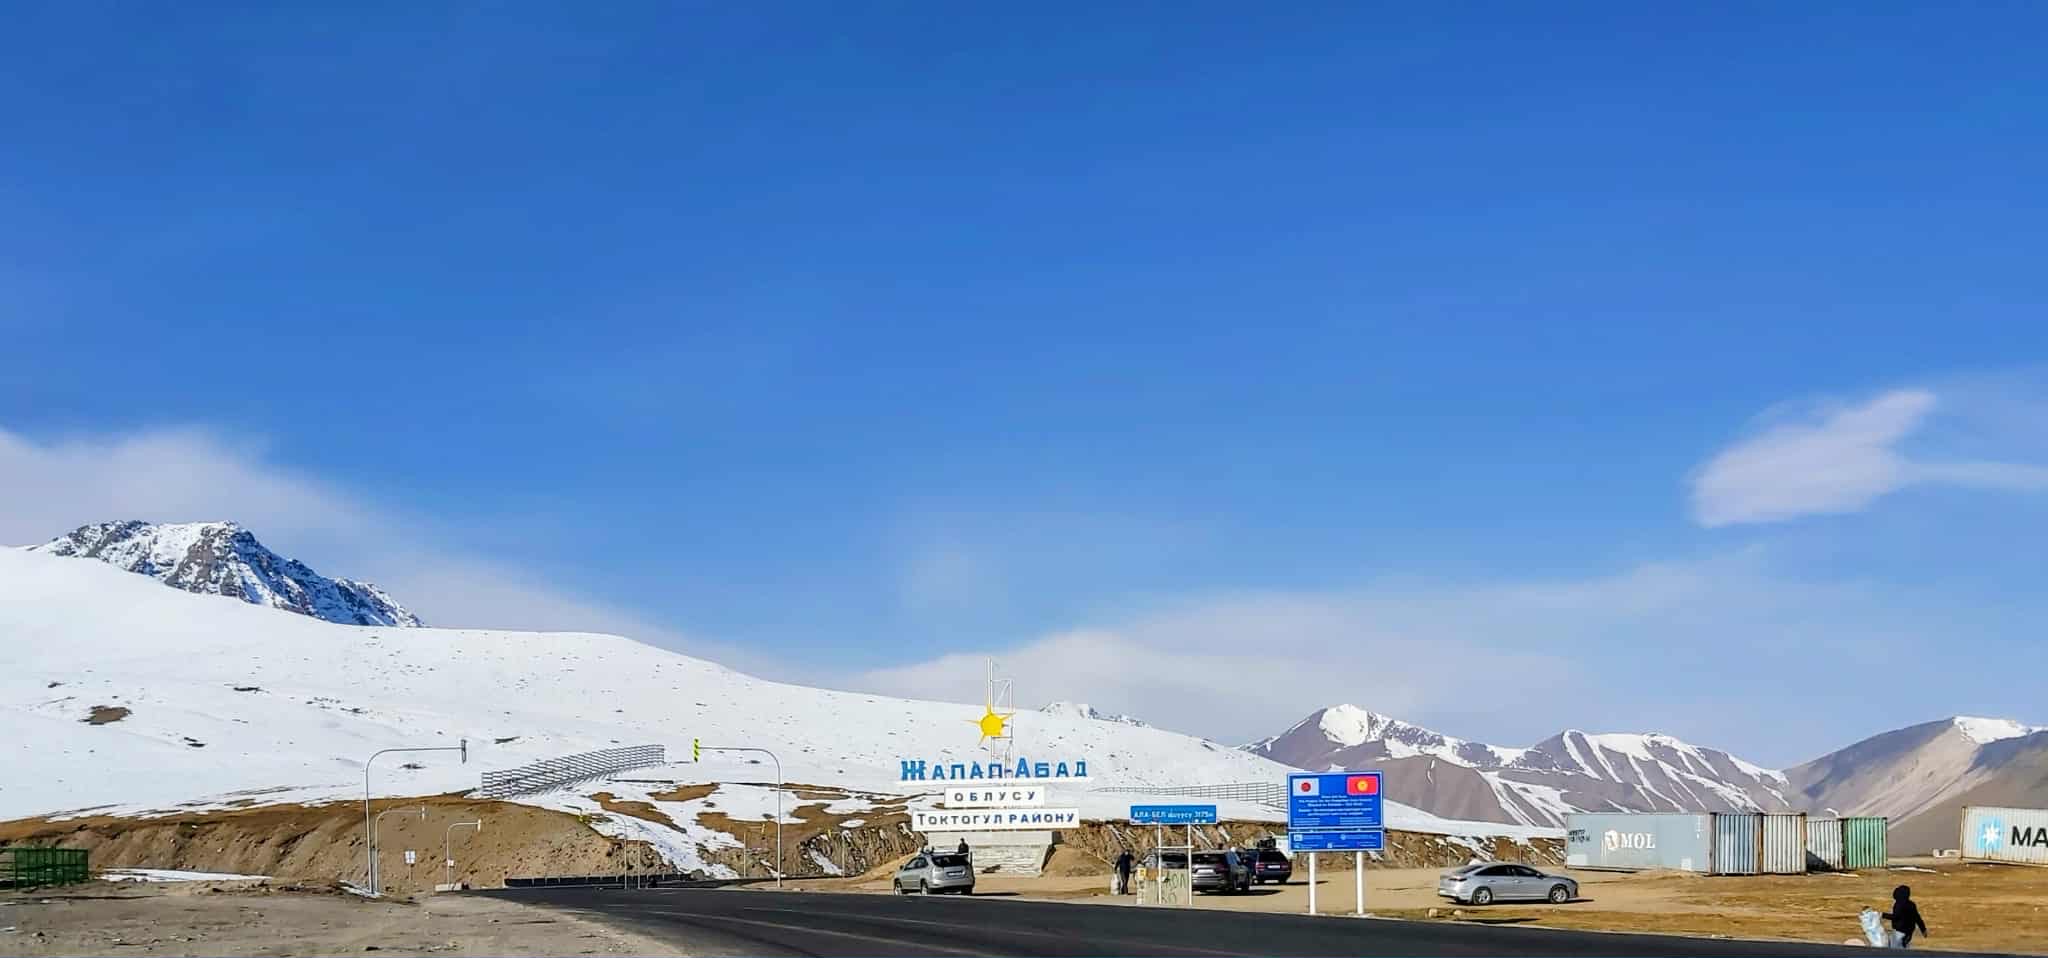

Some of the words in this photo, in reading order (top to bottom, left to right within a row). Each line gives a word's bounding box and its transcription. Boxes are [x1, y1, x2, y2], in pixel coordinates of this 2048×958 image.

[954, 791, 1036, 802] ОБЛУСУ
[917, 813, 1002, 826] ТОКТОГУЛ
[1008, 812, 1075, 824] РАЙОНУ
[1620, 832, 1656, 849] MOL
